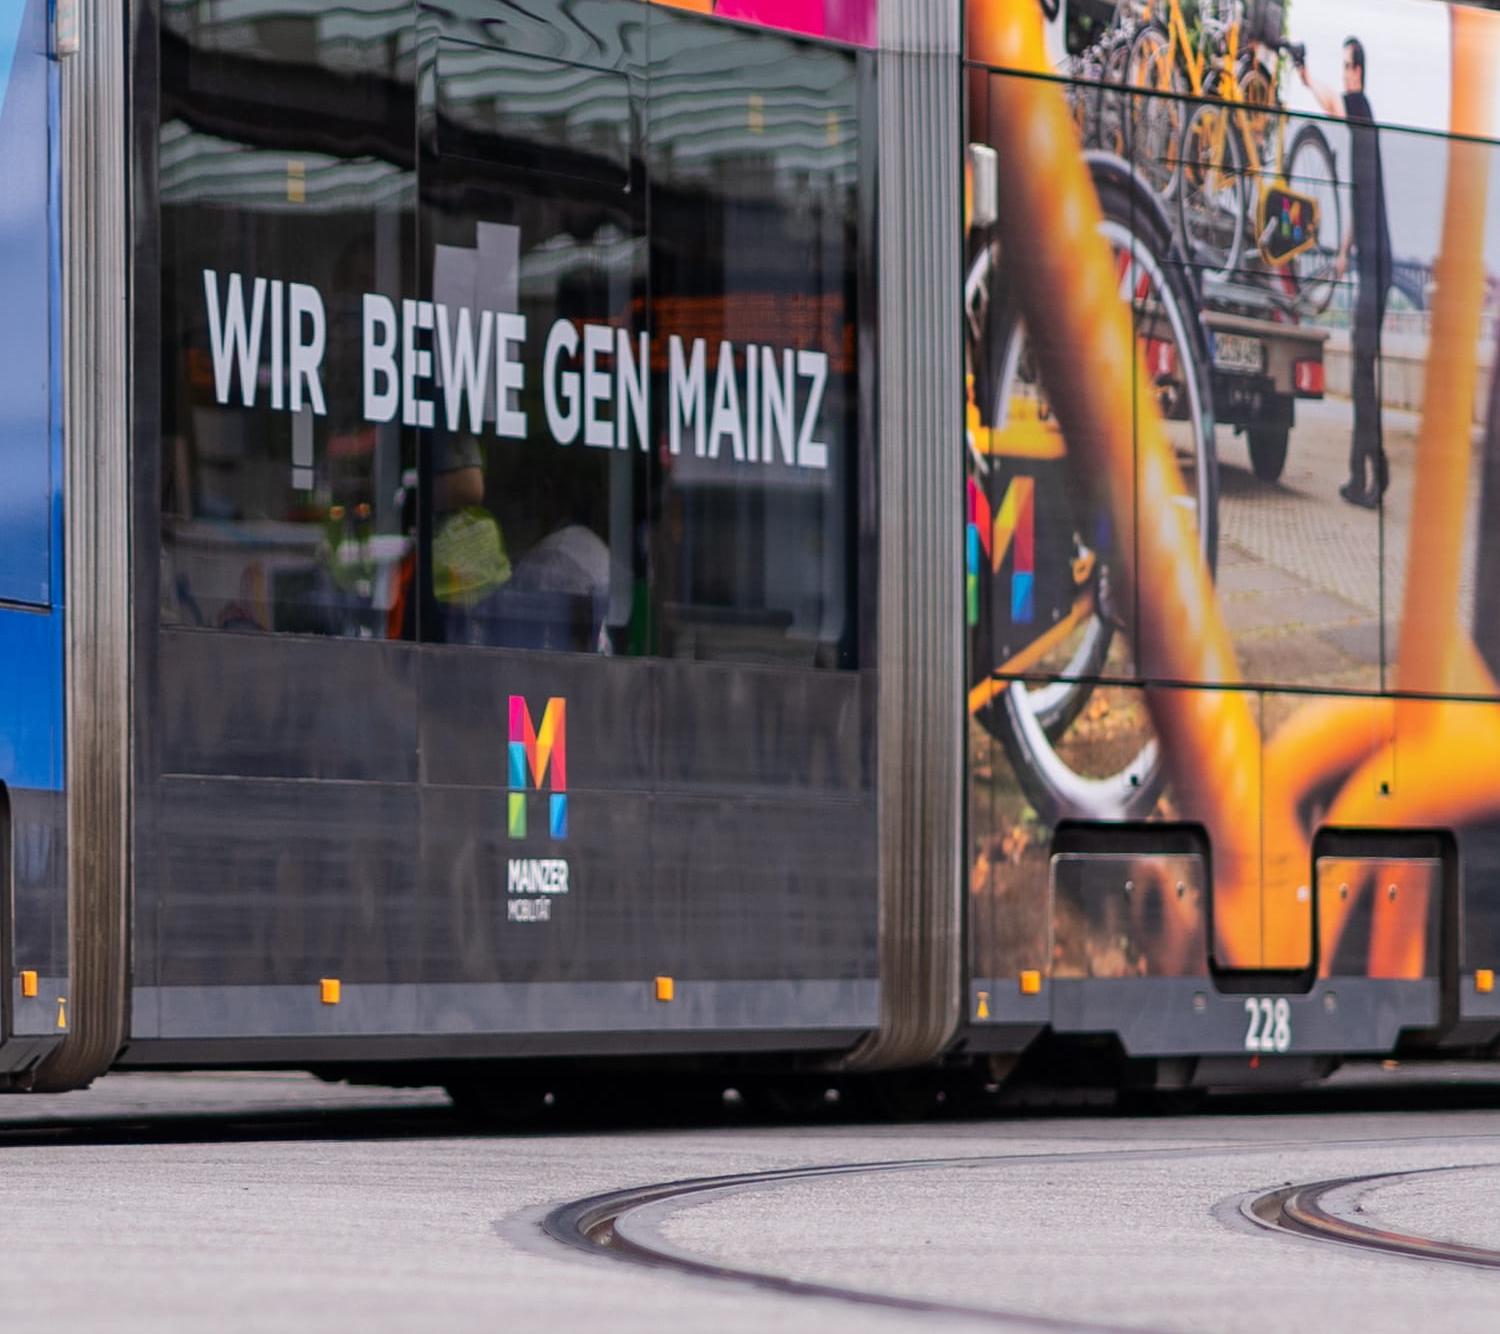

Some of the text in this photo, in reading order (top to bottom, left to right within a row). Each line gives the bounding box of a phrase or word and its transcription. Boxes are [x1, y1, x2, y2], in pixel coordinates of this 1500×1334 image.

[204, 269, 327, 416] WIR
[669, 334, 828, 469] MAINZ
[508, 859, 568, 893] MAINZER
[1245, 996, 1291, 1053] 228
